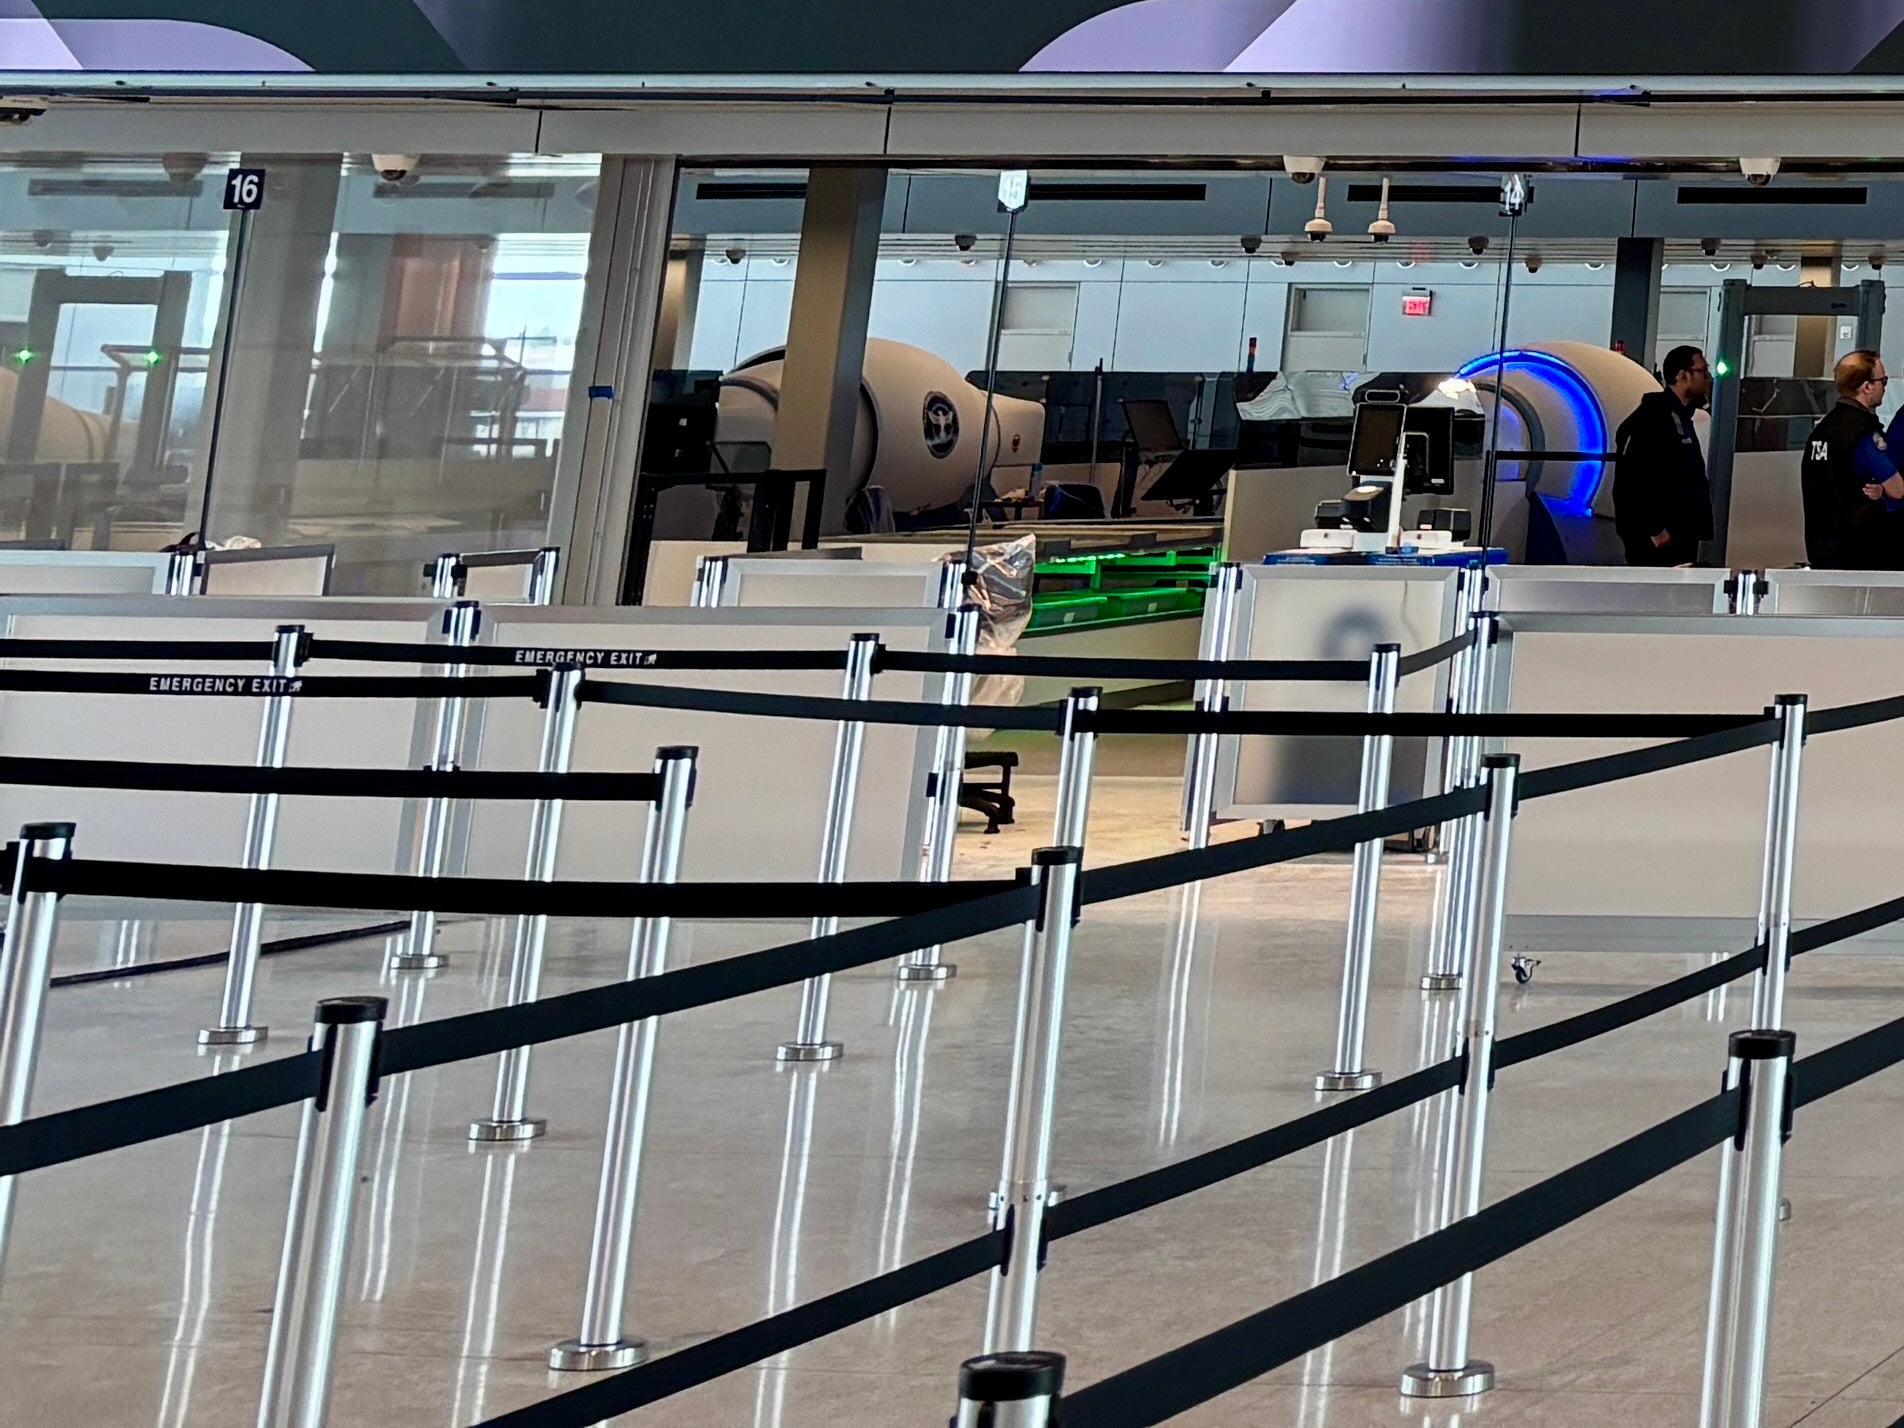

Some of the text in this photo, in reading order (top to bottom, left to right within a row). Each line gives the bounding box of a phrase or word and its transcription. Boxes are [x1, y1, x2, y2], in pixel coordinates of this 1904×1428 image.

[231, 174, 259, 203] 16
[1811, 440, 1828, 461] TSA
[515, 650, 643, 664] EMERGENCY EXIT
[149, 677, 287, 692] EMERGENCY EXIT
